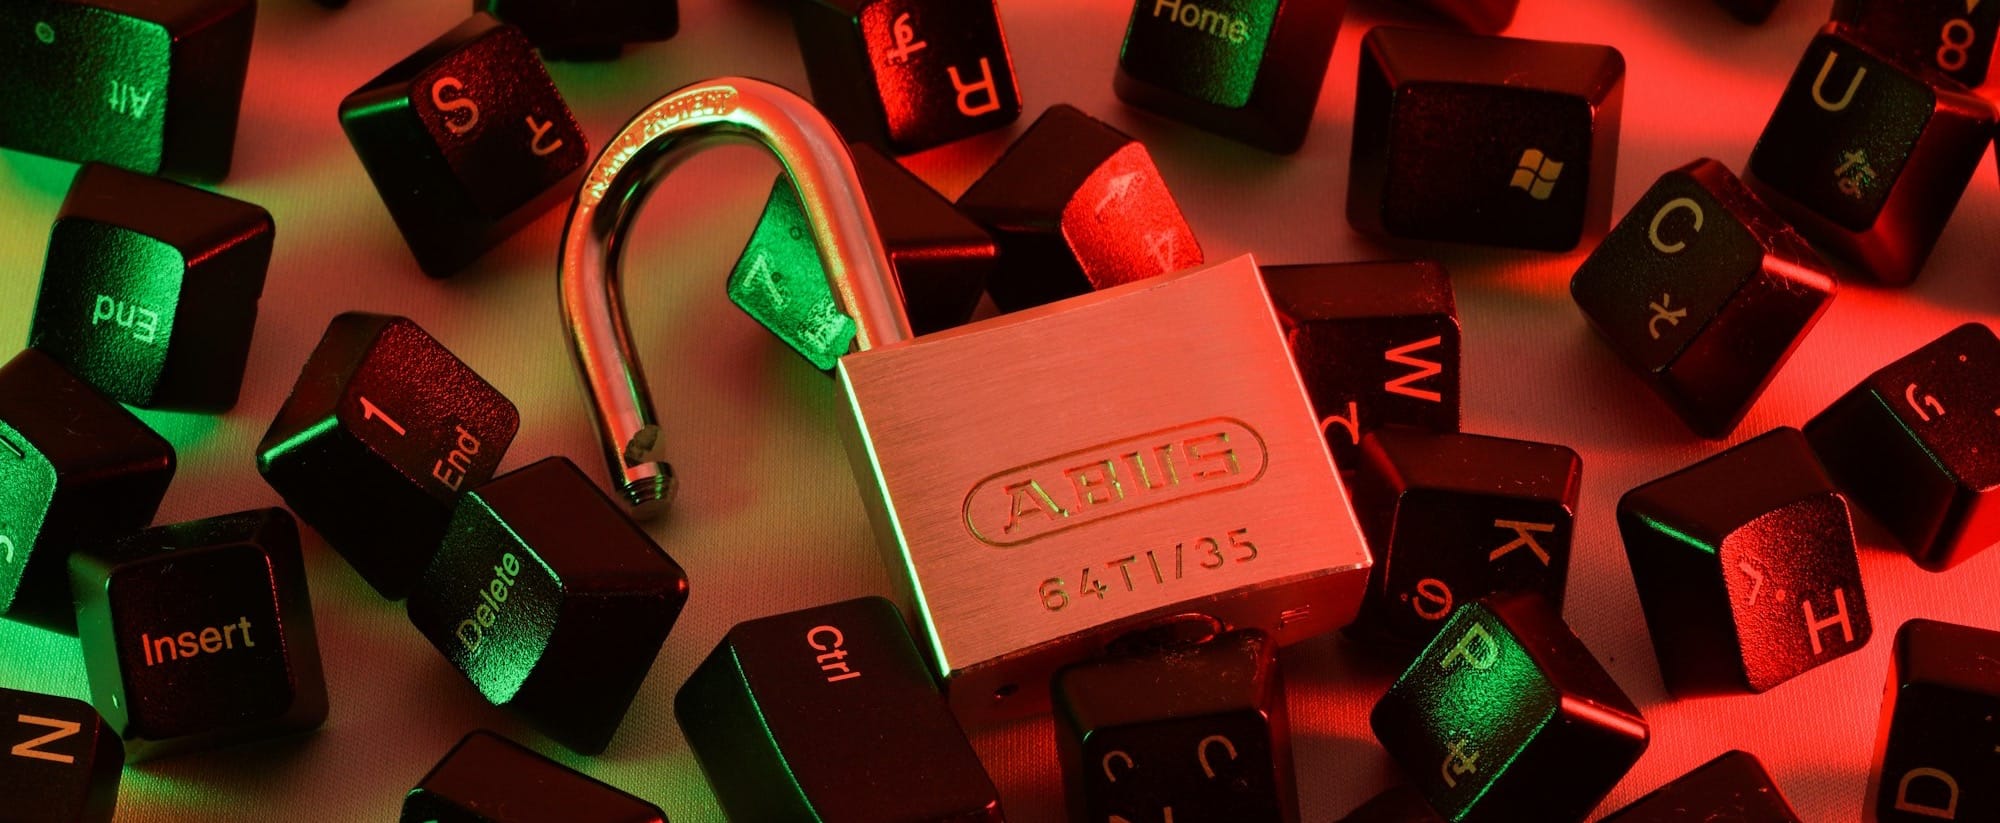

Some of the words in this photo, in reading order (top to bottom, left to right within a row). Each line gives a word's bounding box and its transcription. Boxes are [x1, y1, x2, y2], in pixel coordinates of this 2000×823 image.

[1153, 0, 1248, 43] Home
[1936, 18, 1976, 72] 8
[108, 79, 152, 119] Alt
[431, 76, 481, 135] S
[945, 57, 1000, 118] R
[1811, 50, 1868, 112] U
[1649, 197, 1704, 254] C
[93, 295, 159, 343] End
[1384, 335, 1442, 403] W
[359, 396, 407, 437] 1
[432, 424, 482, 492] End
[1003, 432, 1241, 535] ABUS
[1489, 518, 1556, 567] K
[455, 550, 522, 655] Delete
[1802, 587, 1854, 655] H
[141, 614, 256, 667] Insert
[806, 623, 862, 684] Ctrl
[1440, 621, 1500, 672] P
[10, 713, 82, 766] N
[1893, 767, 1960, 820] D
